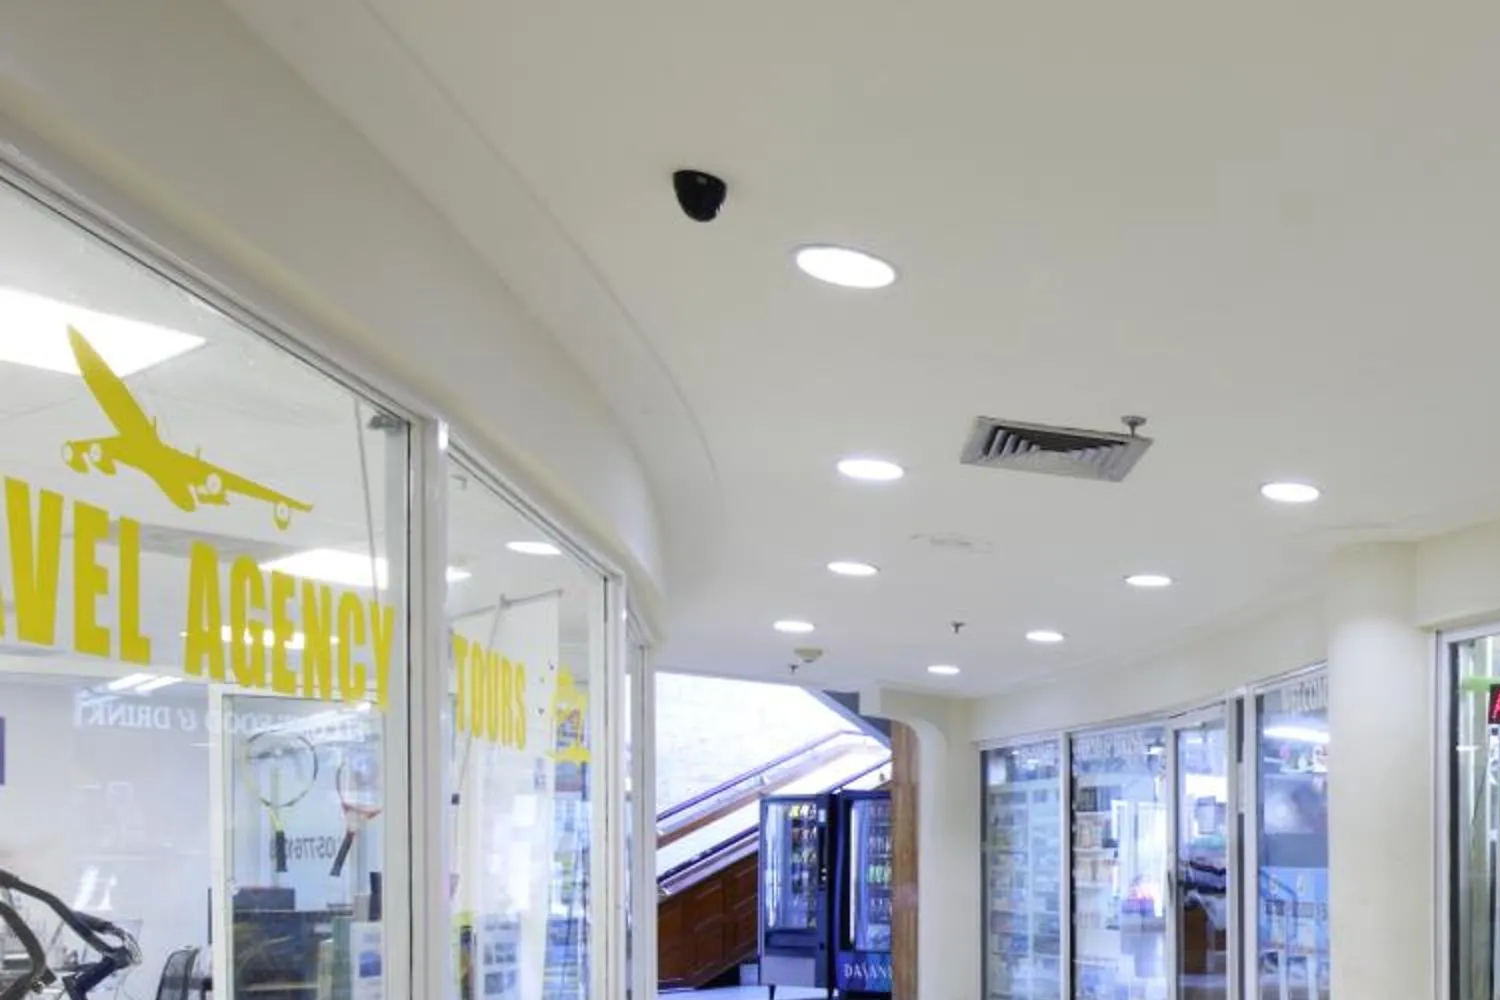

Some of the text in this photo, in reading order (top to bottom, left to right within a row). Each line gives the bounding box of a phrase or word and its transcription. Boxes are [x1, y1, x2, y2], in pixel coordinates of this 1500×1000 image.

[0, 476, 525, 752] VEL AGENCY TOURS
[843, 960, 893, 984] DASAN
